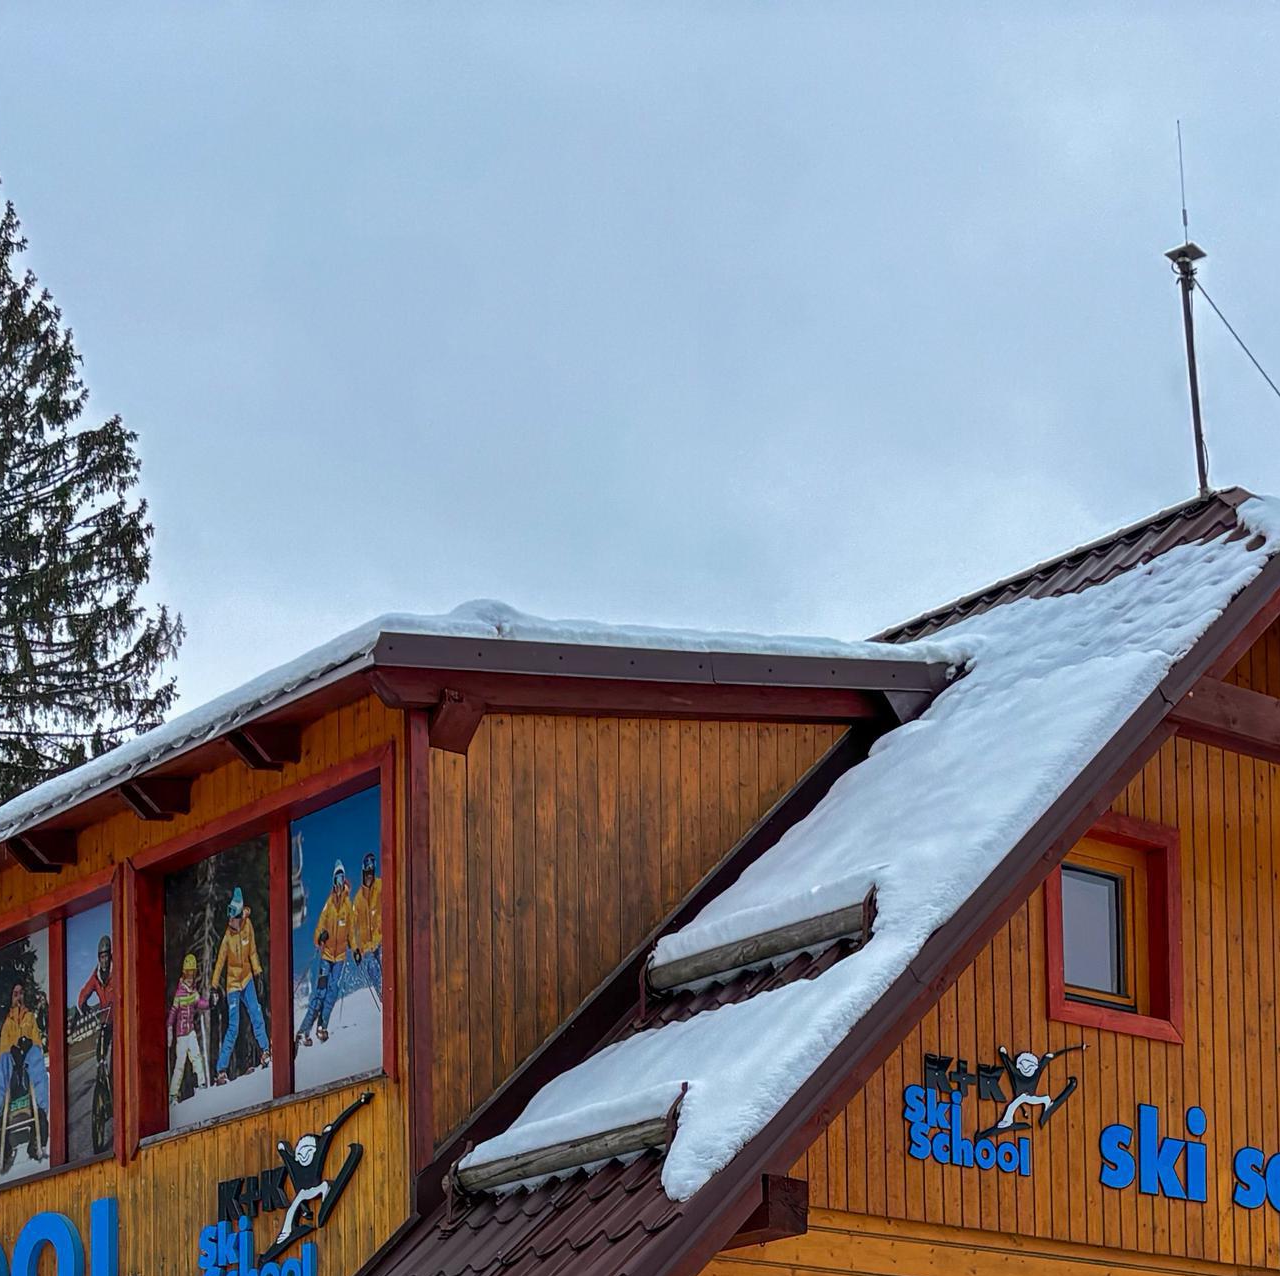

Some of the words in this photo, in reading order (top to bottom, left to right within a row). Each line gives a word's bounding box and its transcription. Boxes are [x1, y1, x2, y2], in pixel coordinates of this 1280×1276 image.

[924, 1054, 1007, 1102] K+K
[903, 1084, 962, 1129] Ski
[909, 1122, 1031, 1177] School
[1099, 1103, 1207, 1203] ski
[218, 1167, 289, 1221] K+K
[198, 1216, 254, 1268] Ski
